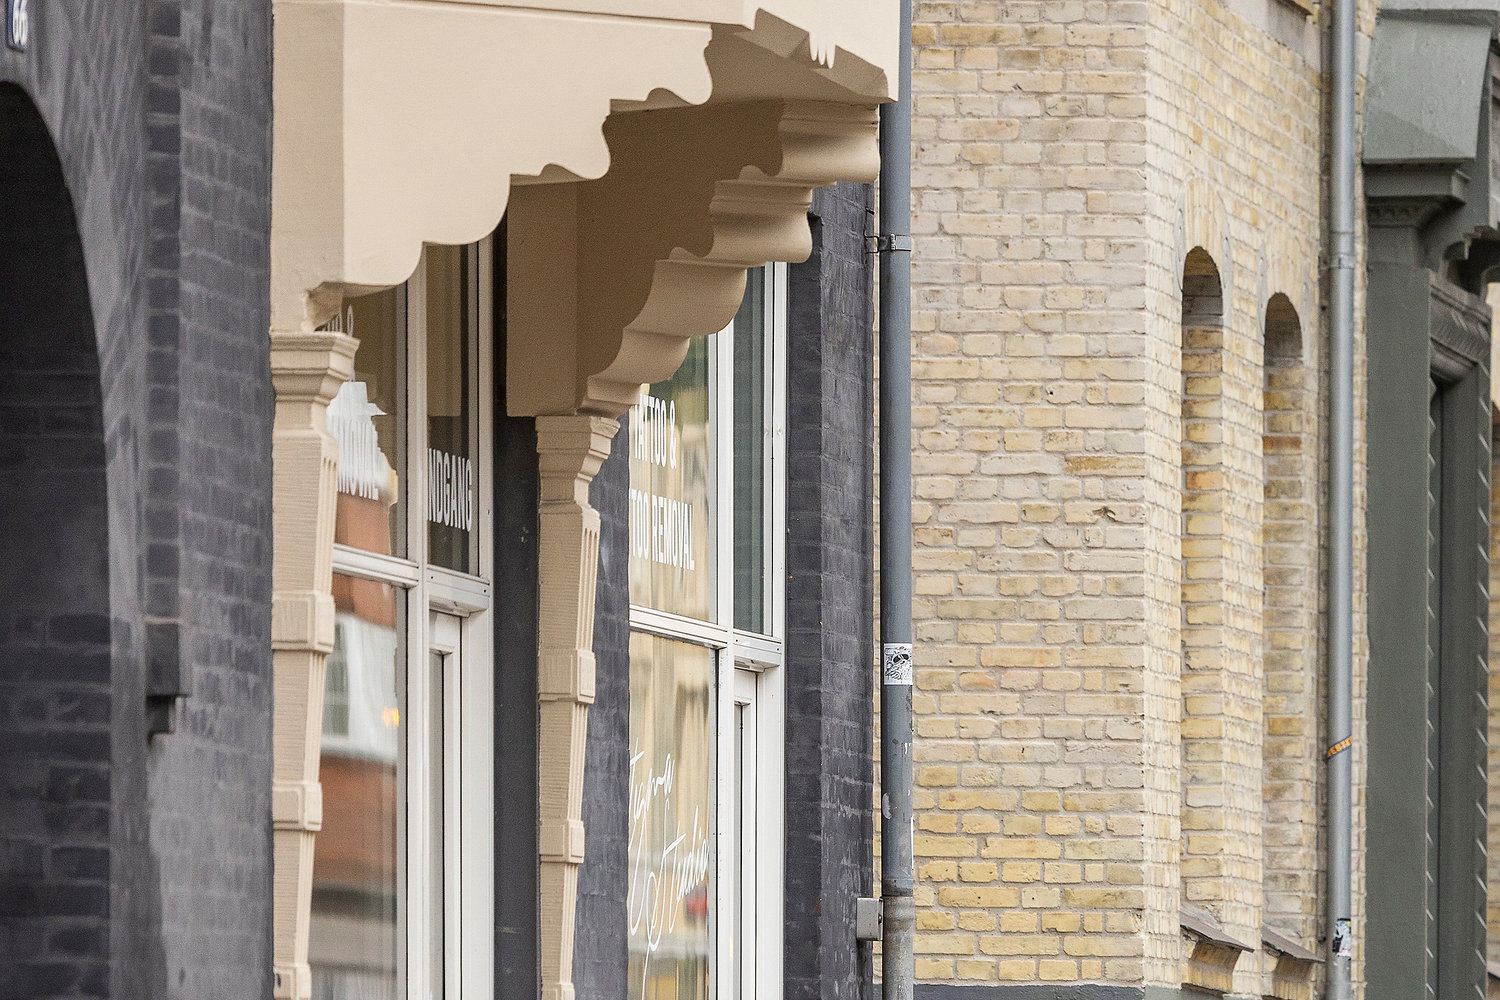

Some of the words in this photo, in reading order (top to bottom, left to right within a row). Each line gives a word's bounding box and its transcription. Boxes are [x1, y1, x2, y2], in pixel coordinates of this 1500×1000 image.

[427, 448, 472, 531] NDGANG
[629, 488, 649, 560] TOO
[652, 494, 694, 571] REMOVAL
